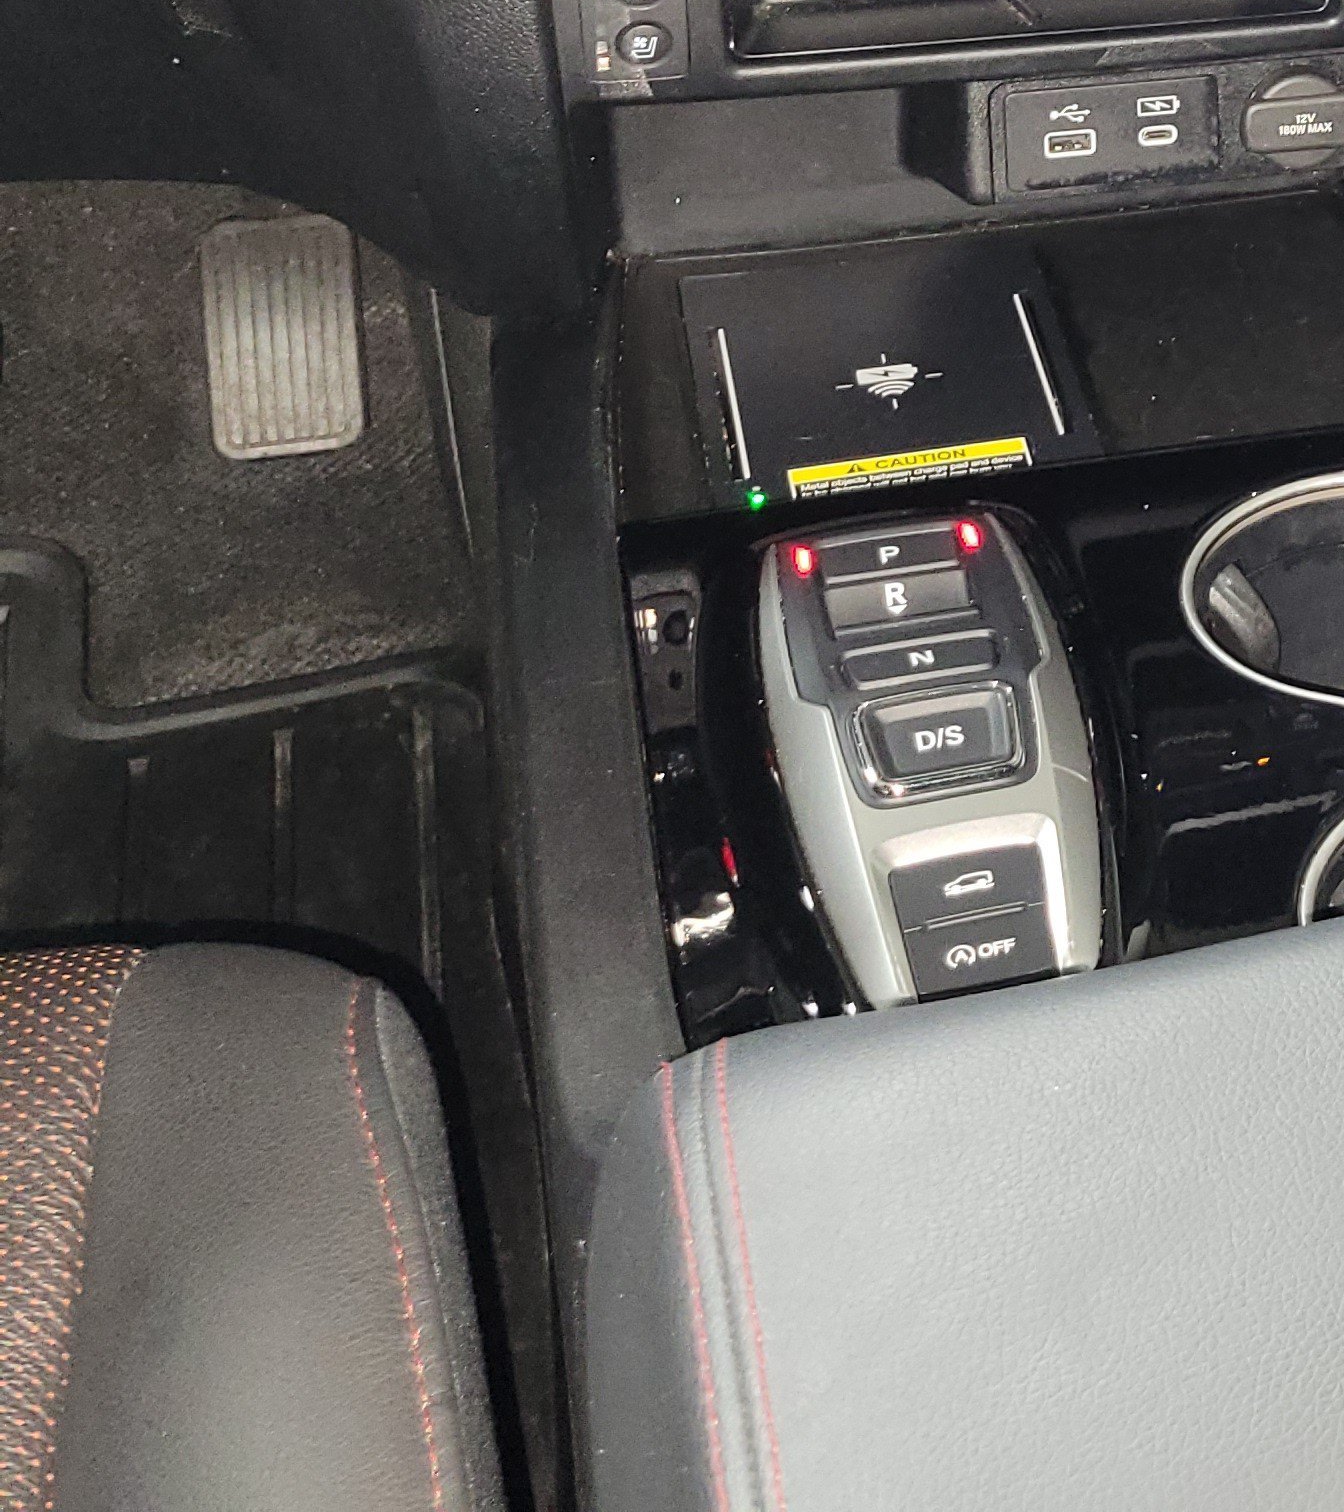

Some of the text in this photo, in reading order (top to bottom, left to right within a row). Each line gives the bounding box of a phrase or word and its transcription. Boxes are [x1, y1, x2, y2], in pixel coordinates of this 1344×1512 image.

[1295, 112, 1316, 124] 12V
[1307, 120, 1333, 134] MAX
[874, 447, 967, 471] CAUTION
[878, 545, 900, 565] P
[884, 582, 908, 607] R
[908, 649, 935, 667] N
[914, 724, 966, 753] D/S
[978, 937, 1016, 959] OFF
